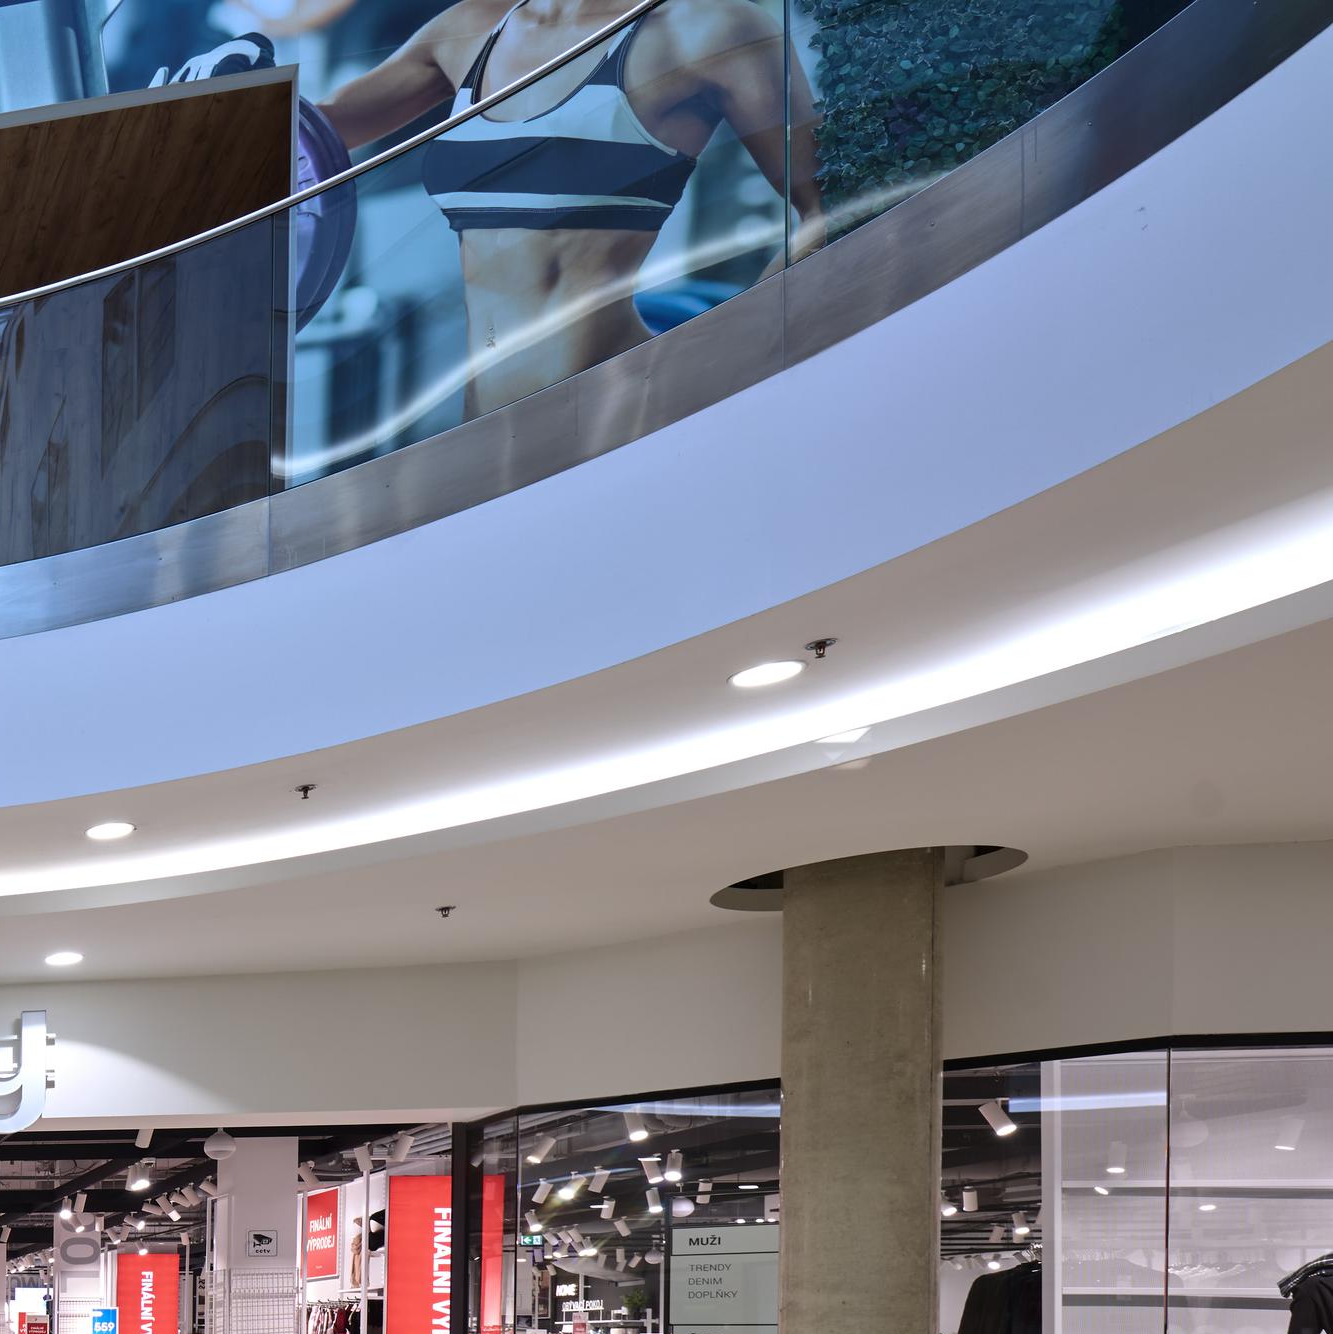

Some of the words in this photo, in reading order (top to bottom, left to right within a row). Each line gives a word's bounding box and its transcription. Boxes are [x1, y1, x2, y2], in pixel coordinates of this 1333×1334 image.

[309, 1212, 333, 1233] FINÁLNÍ
[688, 1234, 721, 1246] MUŽI
[689, 1263, 732, 1272] TRENDY
[688, 1277, 723, 1285] DENIM
[555, 1283, 577, 1296] HOME
[688, 1288, 738, 1299] DOPLŇKY
[140, 1271, 155, 1321] FINÁLNÍ
